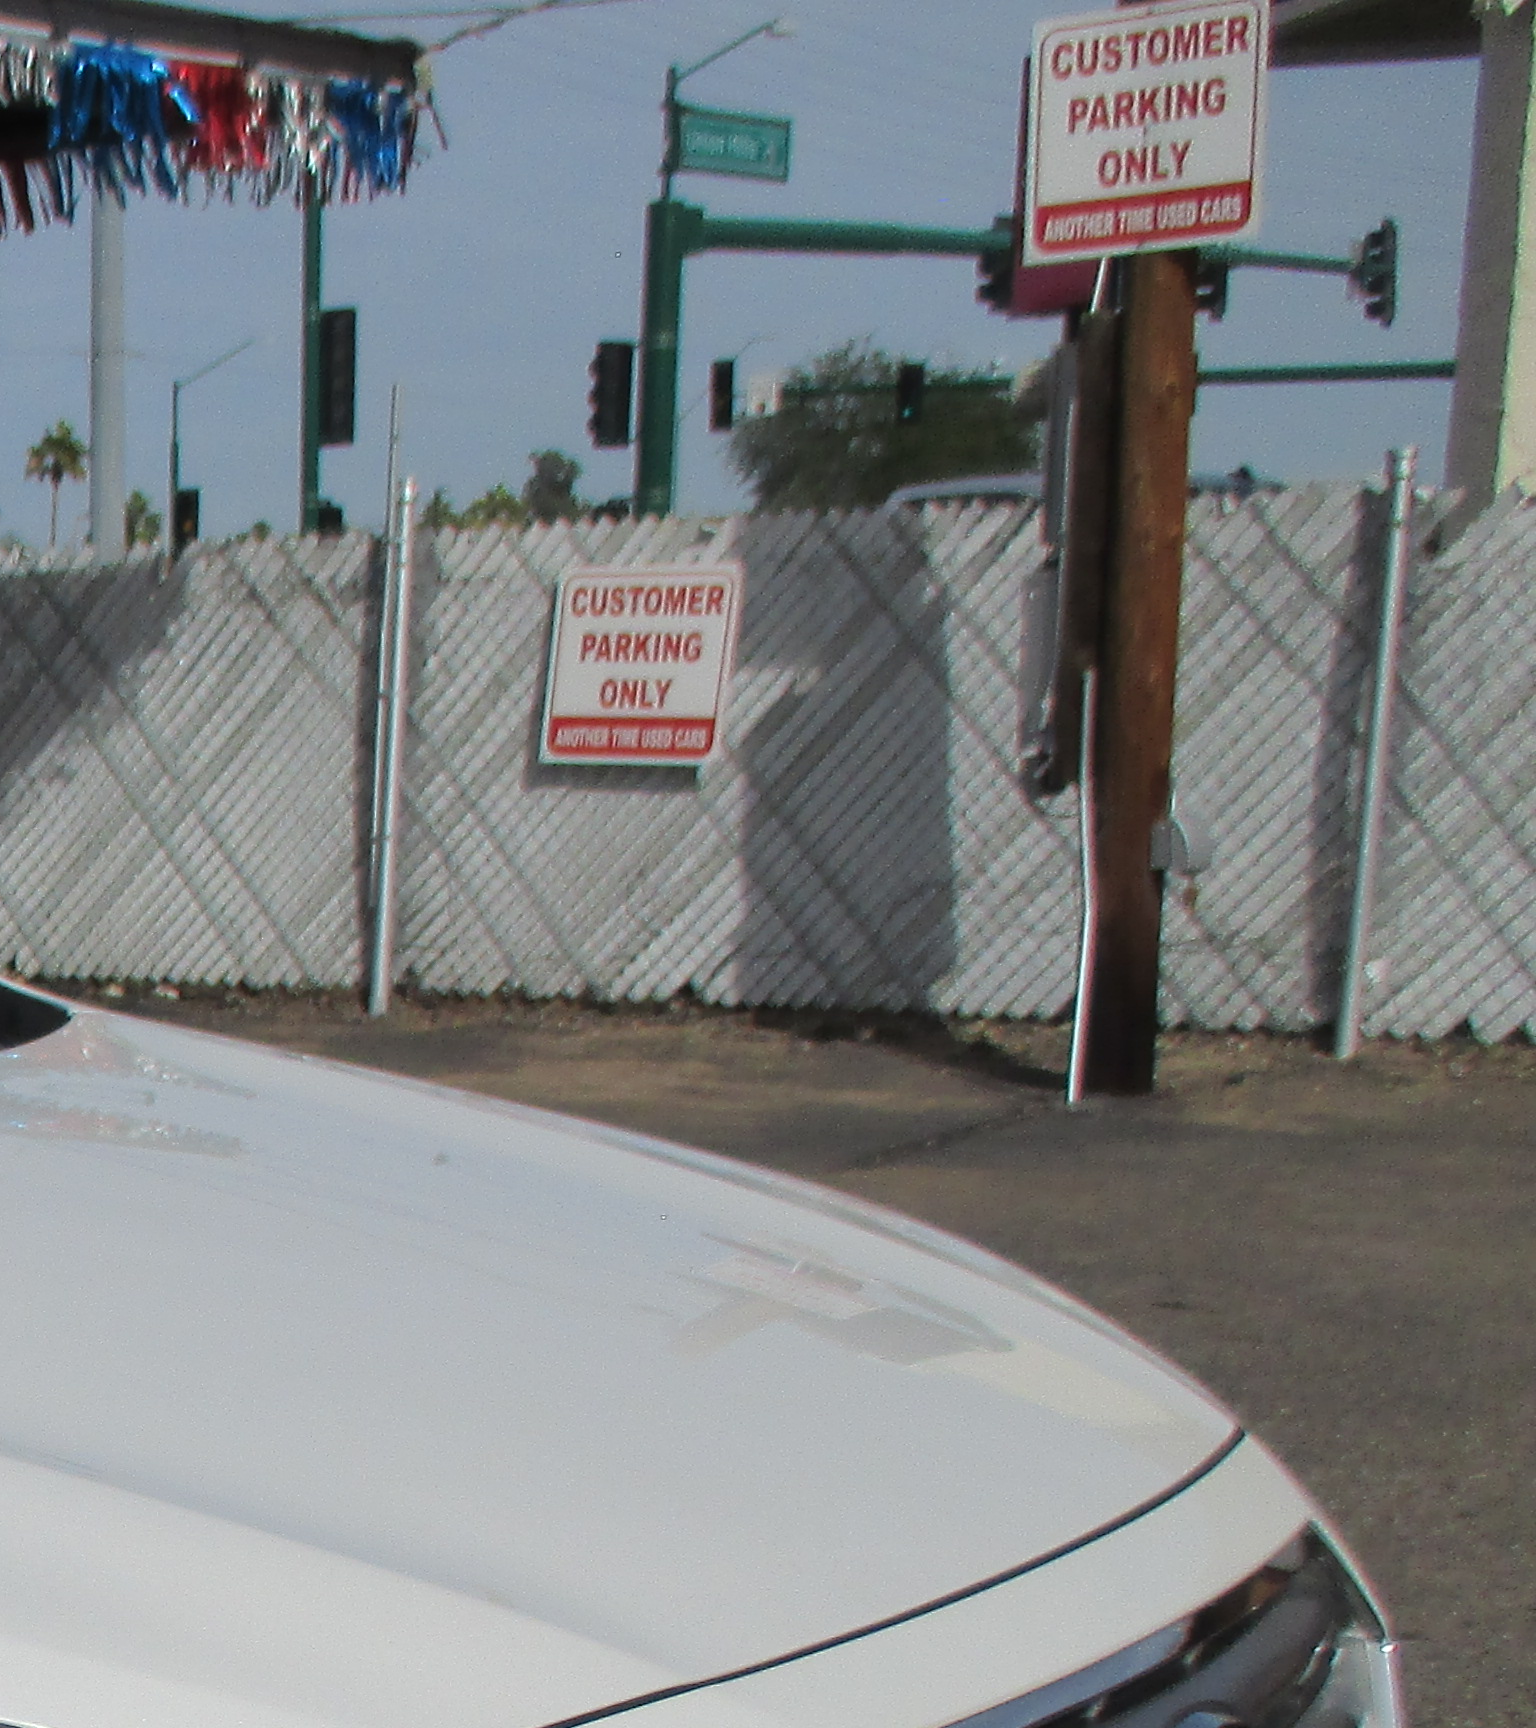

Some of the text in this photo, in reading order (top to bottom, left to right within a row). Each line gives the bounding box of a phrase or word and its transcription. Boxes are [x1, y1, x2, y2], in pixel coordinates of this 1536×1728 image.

[1050, 16, 1250, 80] CUSTOMER
[1066, 78, 1227, 134] PARKING
[1096, 140, 1194, 188] ONLY
[1043, 196, 1242, 242] ANOTHER TIME USED CARS
[570, 586, 725, 618] CUSTOMER
[579, 632, 703, 664] PARKING
[598, 678, 673, 710] ONLY
[555, 728, 610, 747] ANOTHER
[641, 728, 672, 749] USED
[674, 729, 707, 750] CARS
